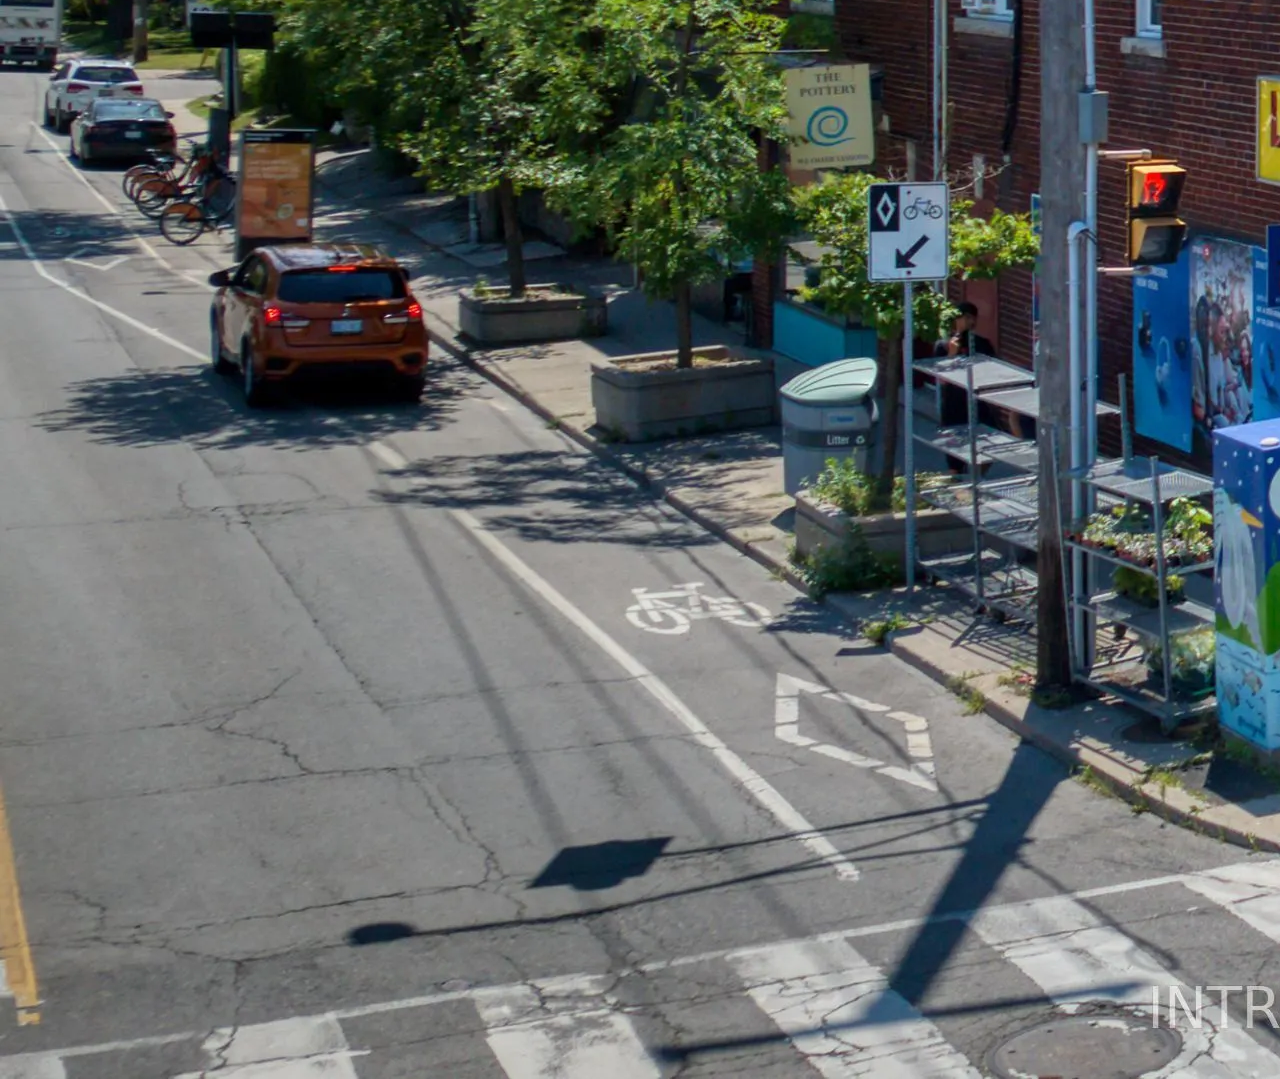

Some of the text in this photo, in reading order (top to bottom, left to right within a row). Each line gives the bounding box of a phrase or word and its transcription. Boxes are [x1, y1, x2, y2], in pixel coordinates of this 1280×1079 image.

[815, 72, 841, 83] THE
[800, 84, 856, 98] POTTERY
[827, 434, 850, 445] Litter
